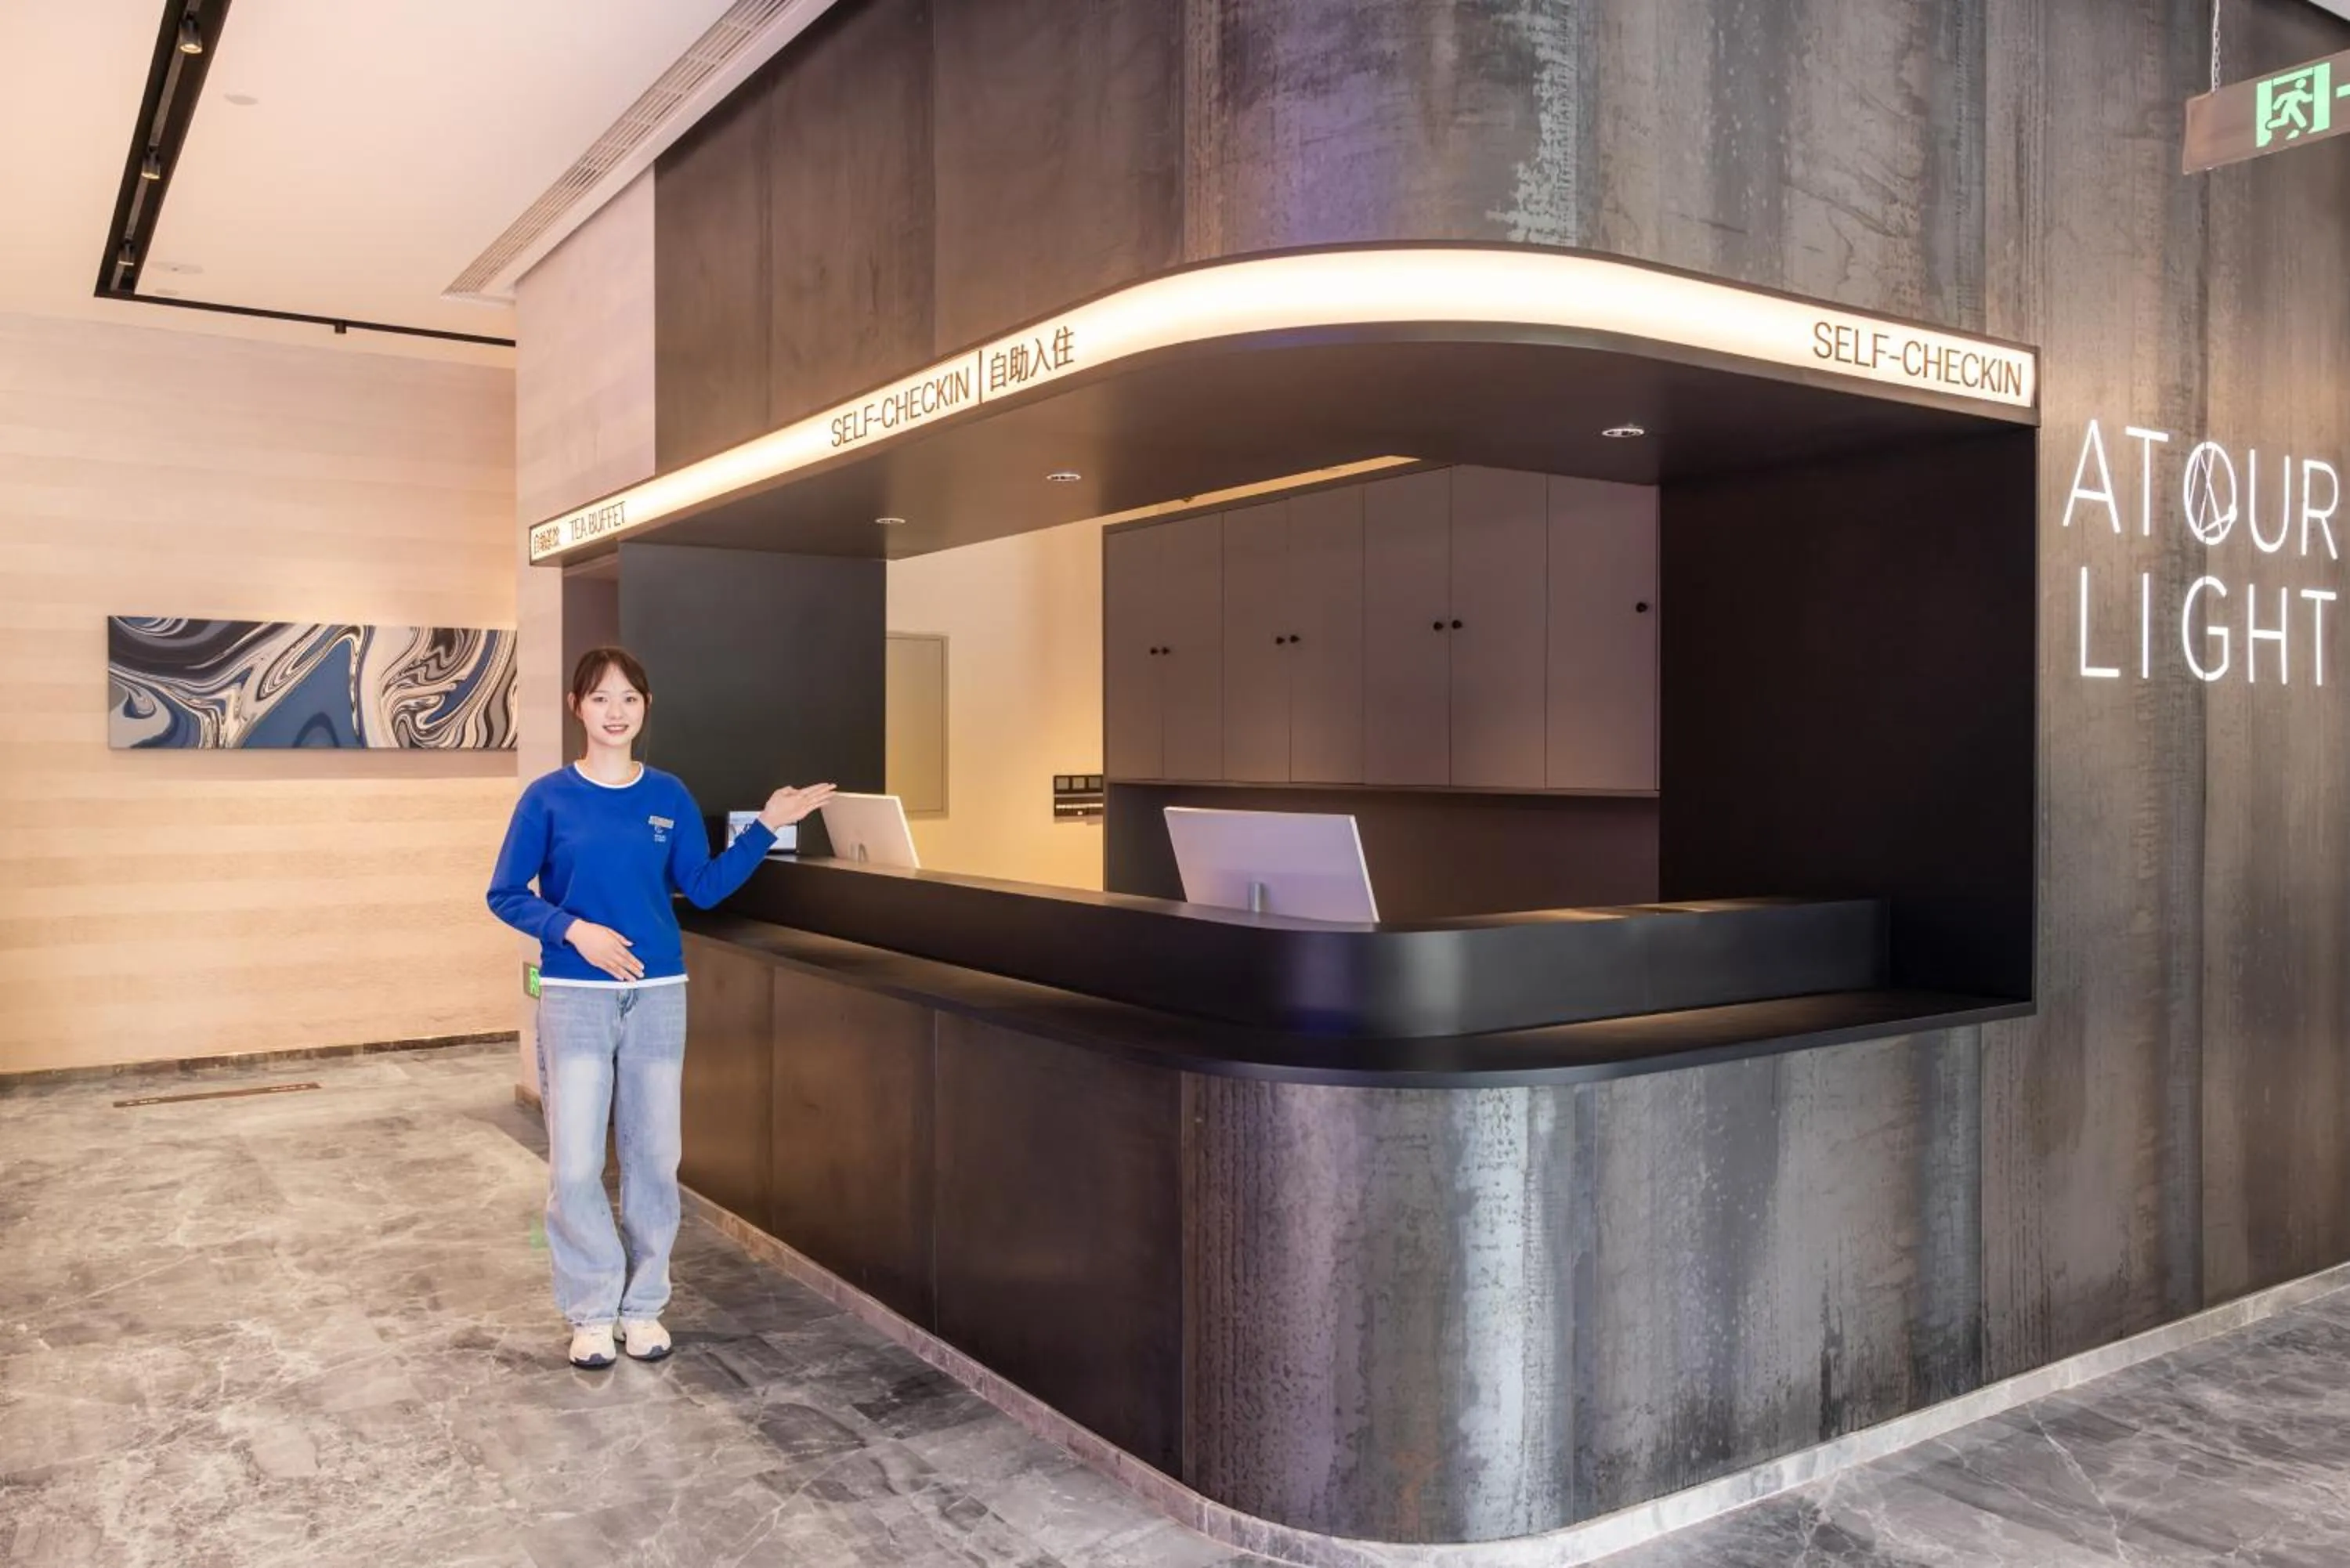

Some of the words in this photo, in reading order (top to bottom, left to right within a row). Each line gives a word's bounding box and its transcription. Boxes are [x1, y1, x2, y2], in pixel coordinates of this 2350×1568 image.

[831, 367, 971, 447] SELF-CHECKIN
[989, 326, 1074, 392] 自助入住
[1813, 321, 2023, 396] SELF-CHECKIN
[568, 517, 588, 541] TEA
[588, 501, 626, 534] BUFFET
[2063, 419, 2339, 560] ATOUR
[2080, 566, 2337, 687] LIGHT
